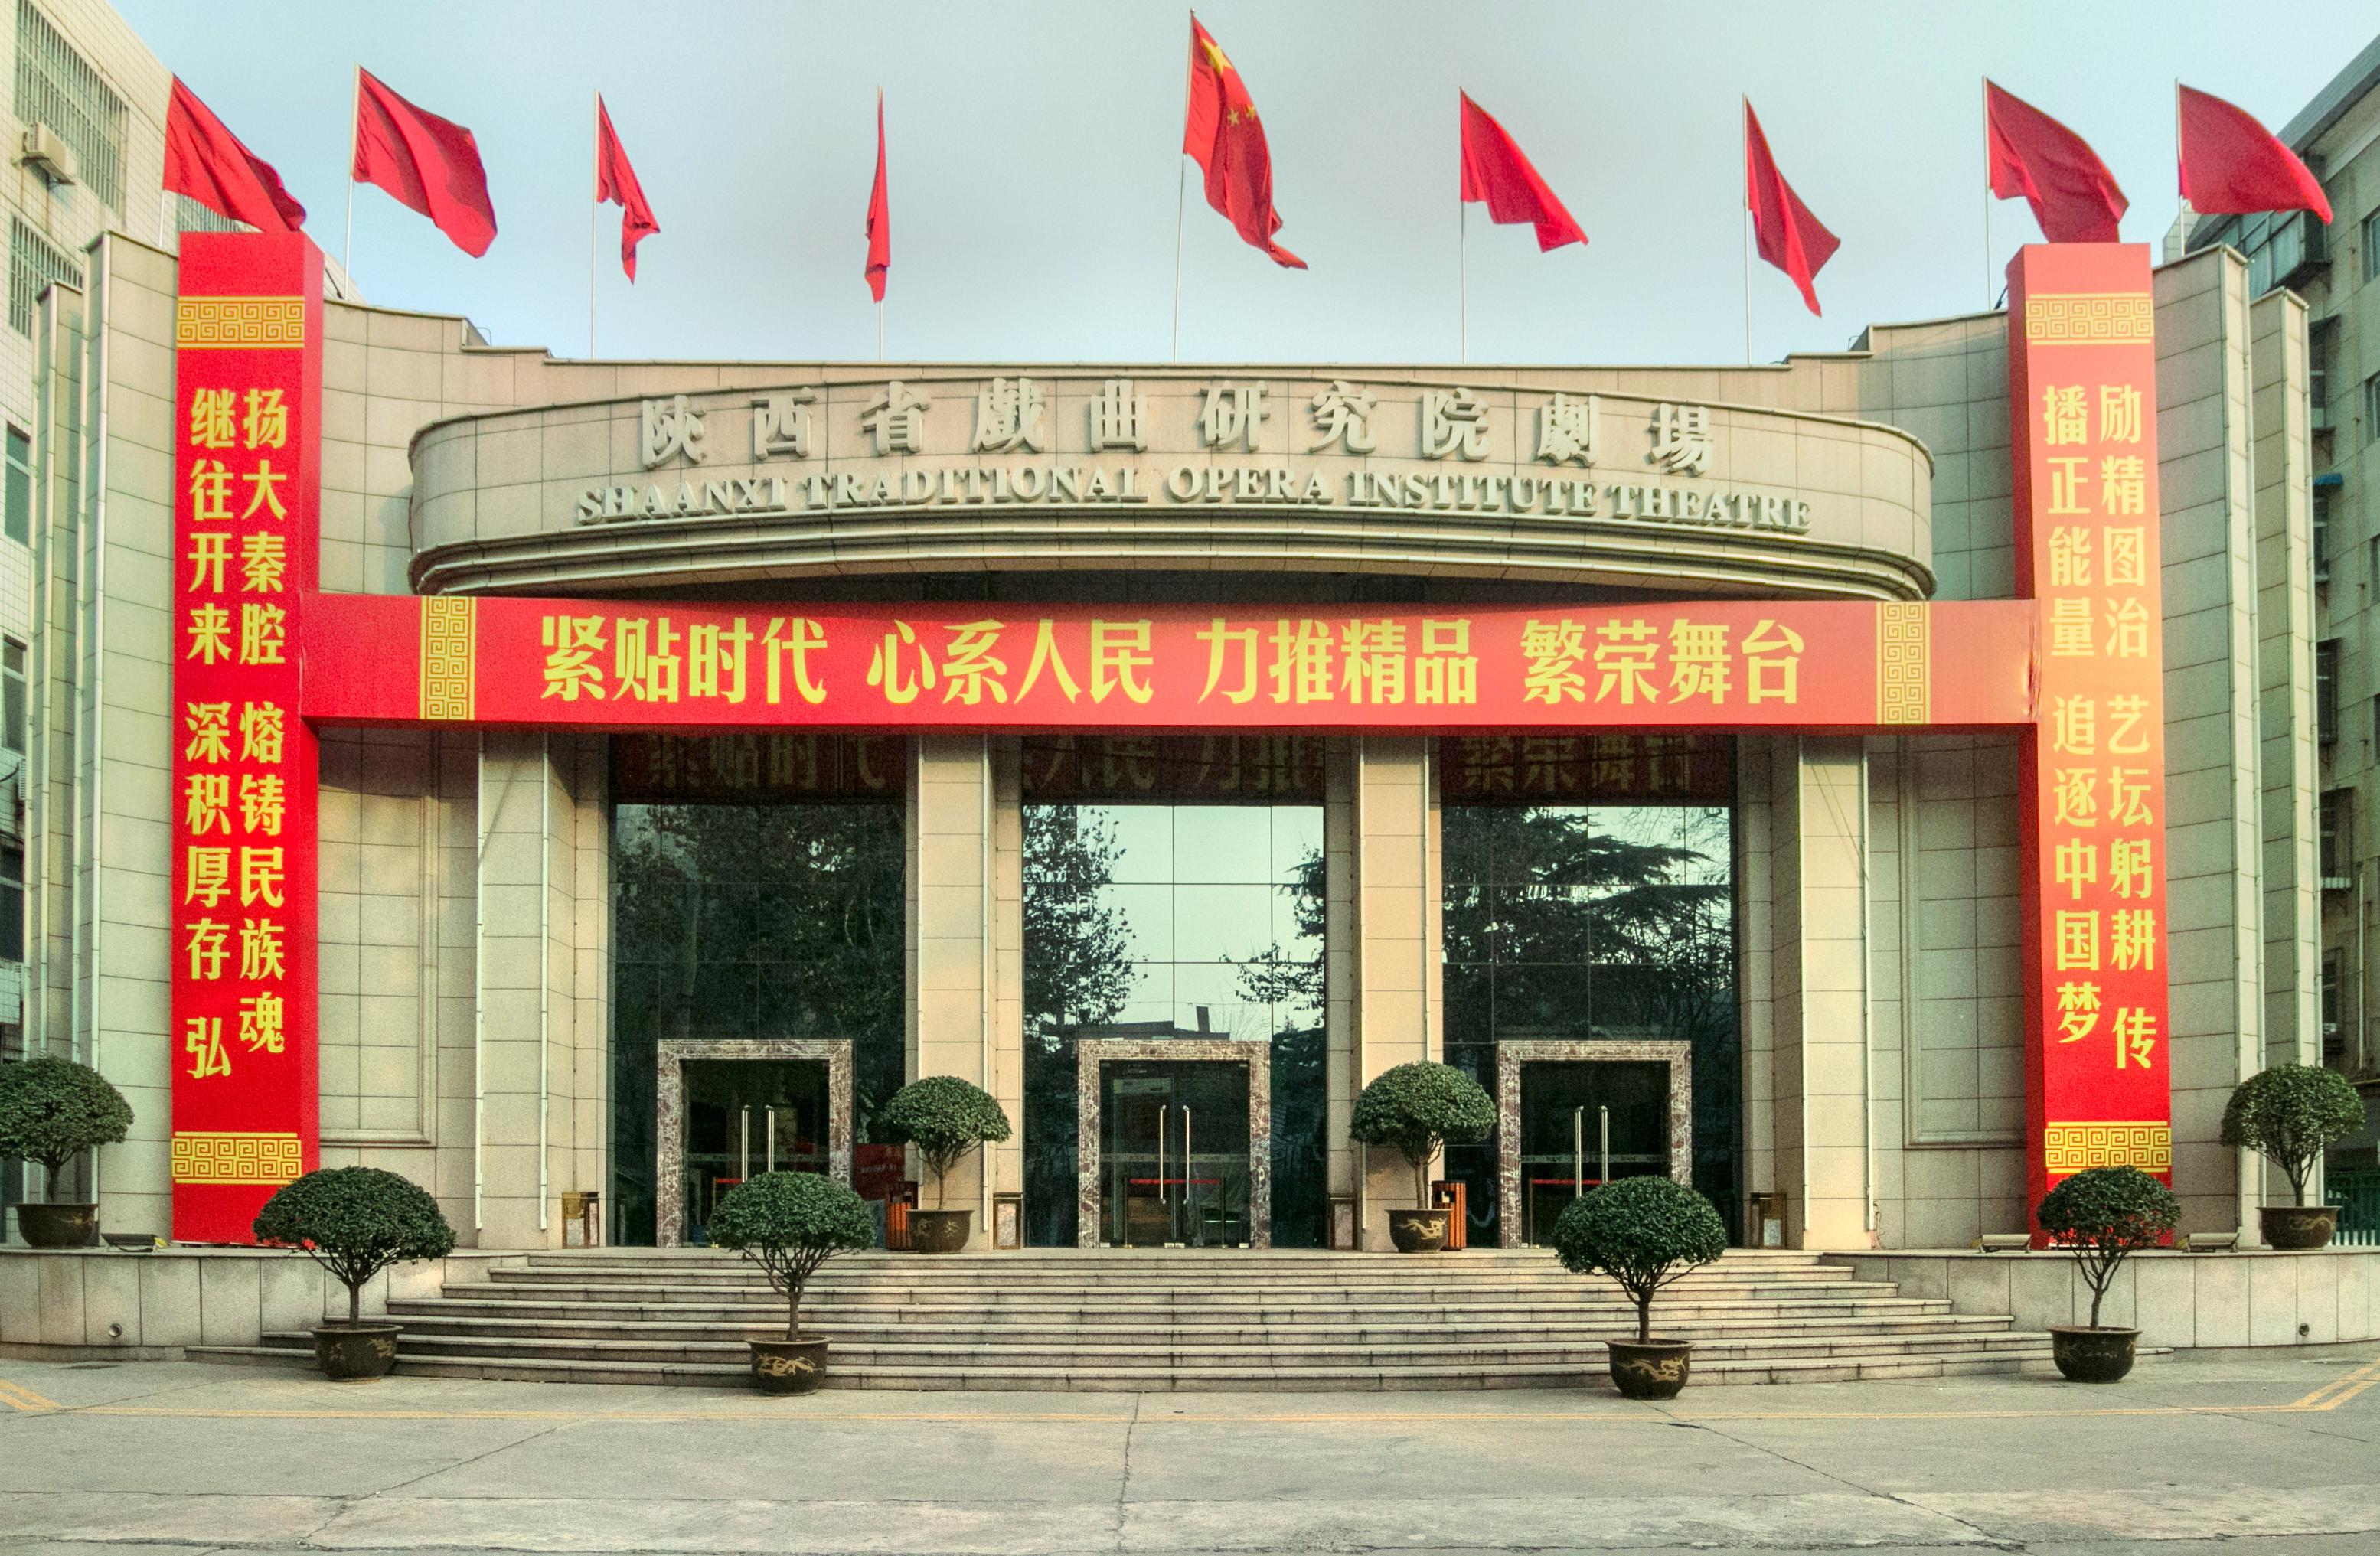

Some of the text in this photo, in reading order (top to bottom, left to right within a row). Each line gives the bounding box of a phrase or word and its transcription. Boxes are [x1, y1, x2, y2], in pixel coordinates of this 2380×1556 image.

[185, 389, 235, 1079] 继往开来 深积厚存 弘
[239, 389, 287, 1054] 扬大秦腔 熔铸民族魂
[541, 615, 1804, 705] 紧贴时代 心系人民 力推精品 繁荣舞台
[577, 465, 1814, 533] SHAANXI TRADITIONAL OPERA INSTITUTE THEATRE
[2043, 385, 2101, 1043] 播正能量 追逐中国梦
[2100, 384, 2156, 1069] 励精图治 艺坛躬耕 传
